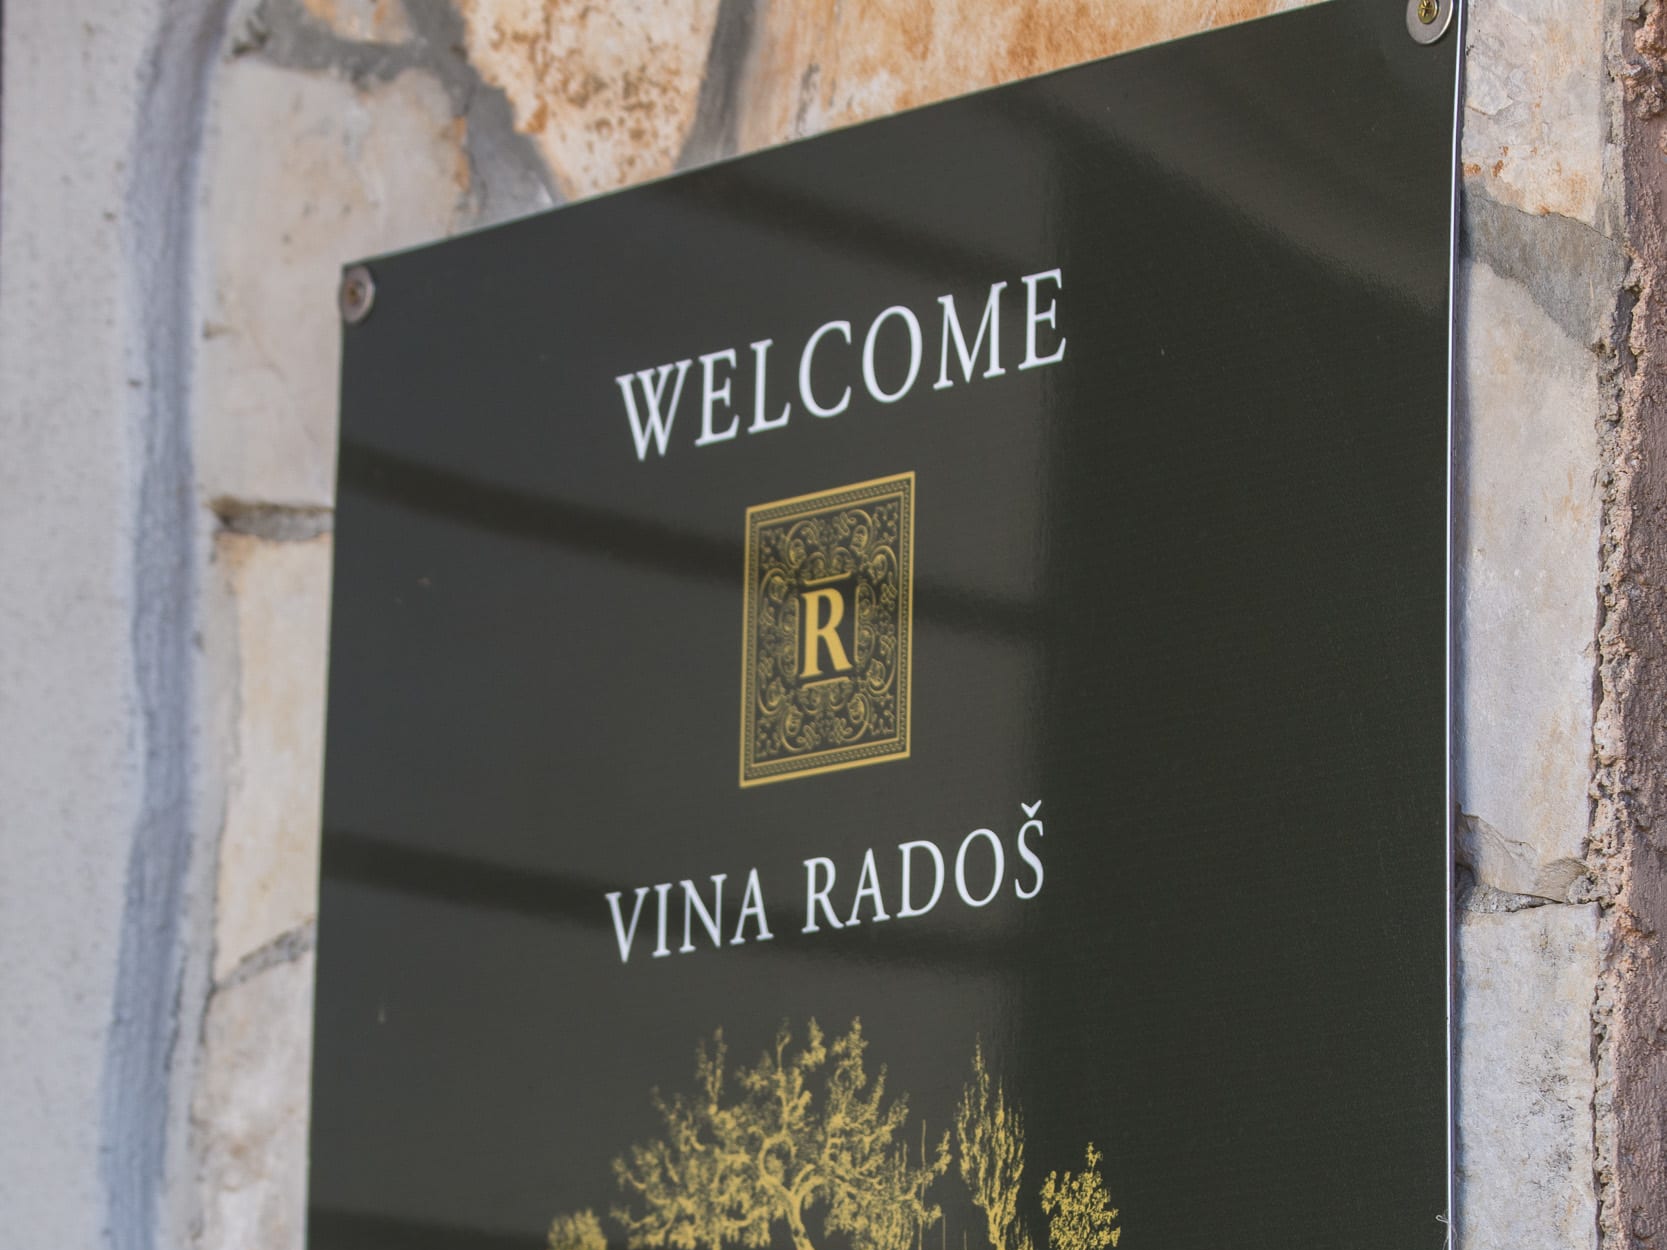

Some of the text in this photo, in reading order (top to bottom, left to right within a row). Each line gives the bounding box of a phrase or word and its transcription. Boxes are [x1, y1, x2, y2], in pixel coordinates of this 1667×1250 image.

[615, 268, 1067, 461] WELCOME
[800, 587, 852, 678] R
[605, 799, 1044, 963] VINA RADOŠ
